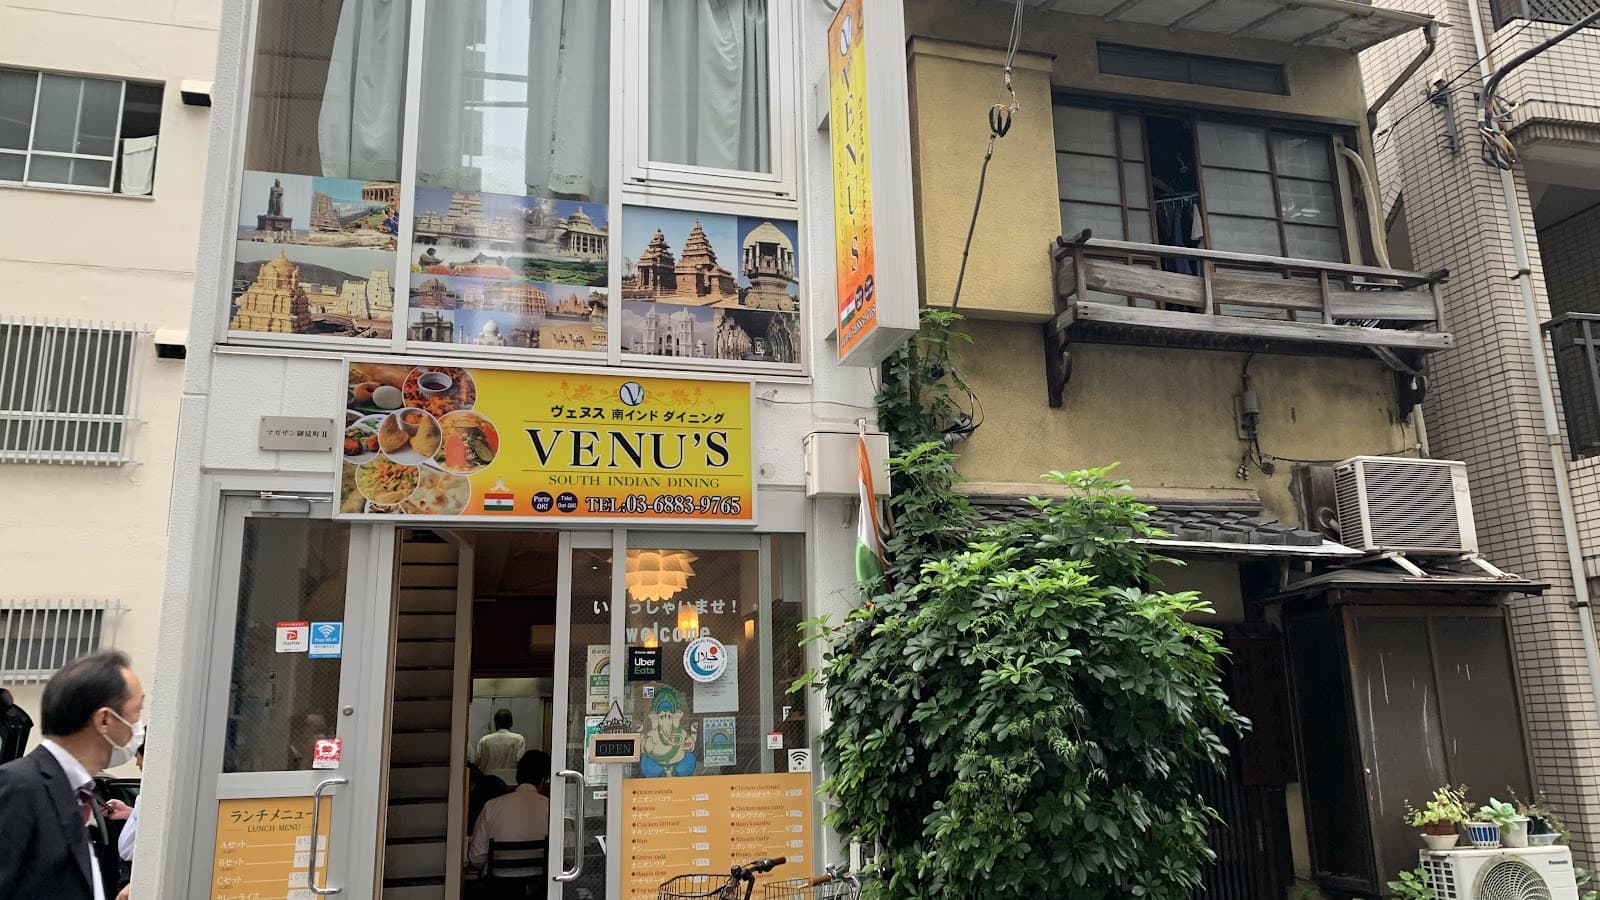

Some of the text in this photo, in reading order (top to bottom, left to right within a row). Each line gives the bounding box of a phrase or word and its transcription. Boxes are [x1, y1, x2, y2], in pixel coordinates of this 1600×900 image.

[551, 405, 725, 424] ヴェヌス 南インド ダイニング
[525, 428, 730, 470] VENU'S
[549, 474, 720, 489] SOUTH INDIAN DINING
[585, 494, 741, 514] TEL:03-6883-9765
[626, 621, 711, 643] welcome
[634, 657, 656, 666] Uber
[634, 667, 655, 675] Eats
[599, 744, 631, 754] OPEN
[230, 808, 314, 824] ランチメニュー
[247, 824, 301, 833] LUNCH MENU
